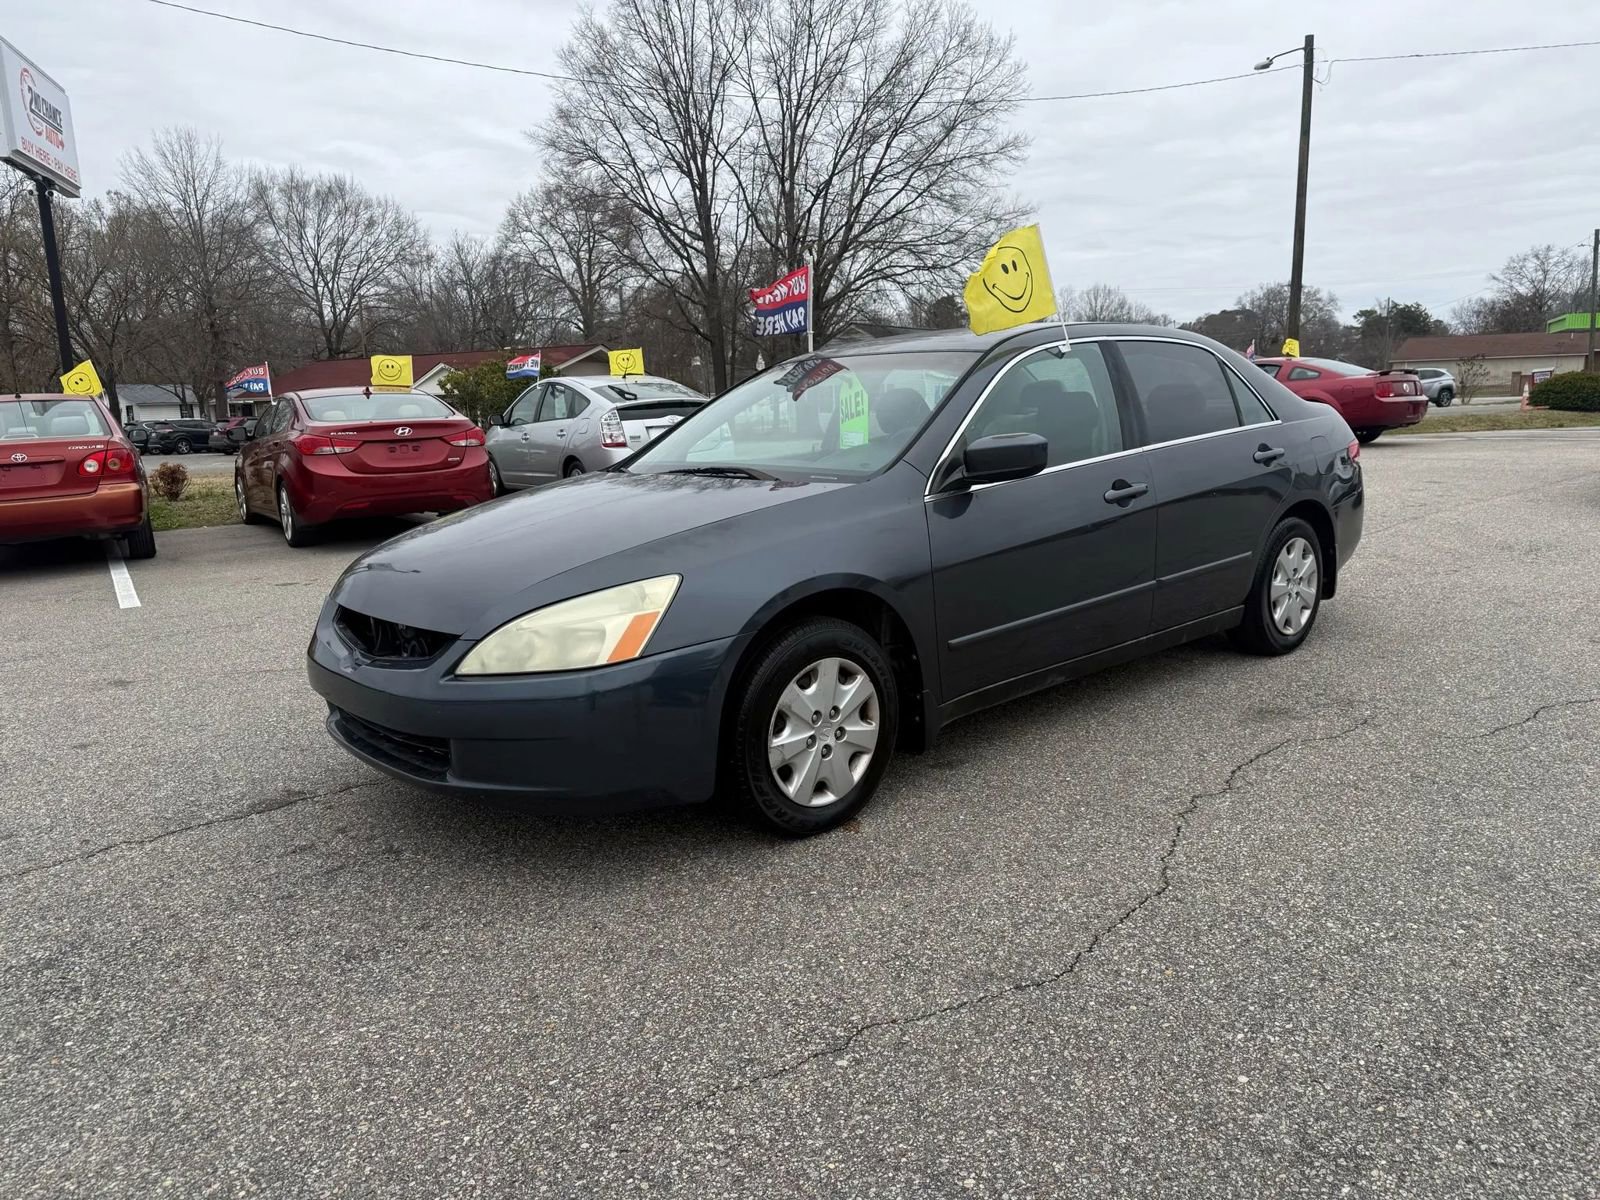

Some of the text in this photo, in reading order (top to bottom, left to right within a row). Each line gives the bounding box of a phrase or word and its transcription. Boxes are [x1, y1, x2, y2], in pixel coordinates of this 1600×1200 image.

[41, 97, 63, 129] CHANCE
[21, 136, 78, 182] BUY HERE PAY HERE
[840, 389, 865, 425] SALE!
